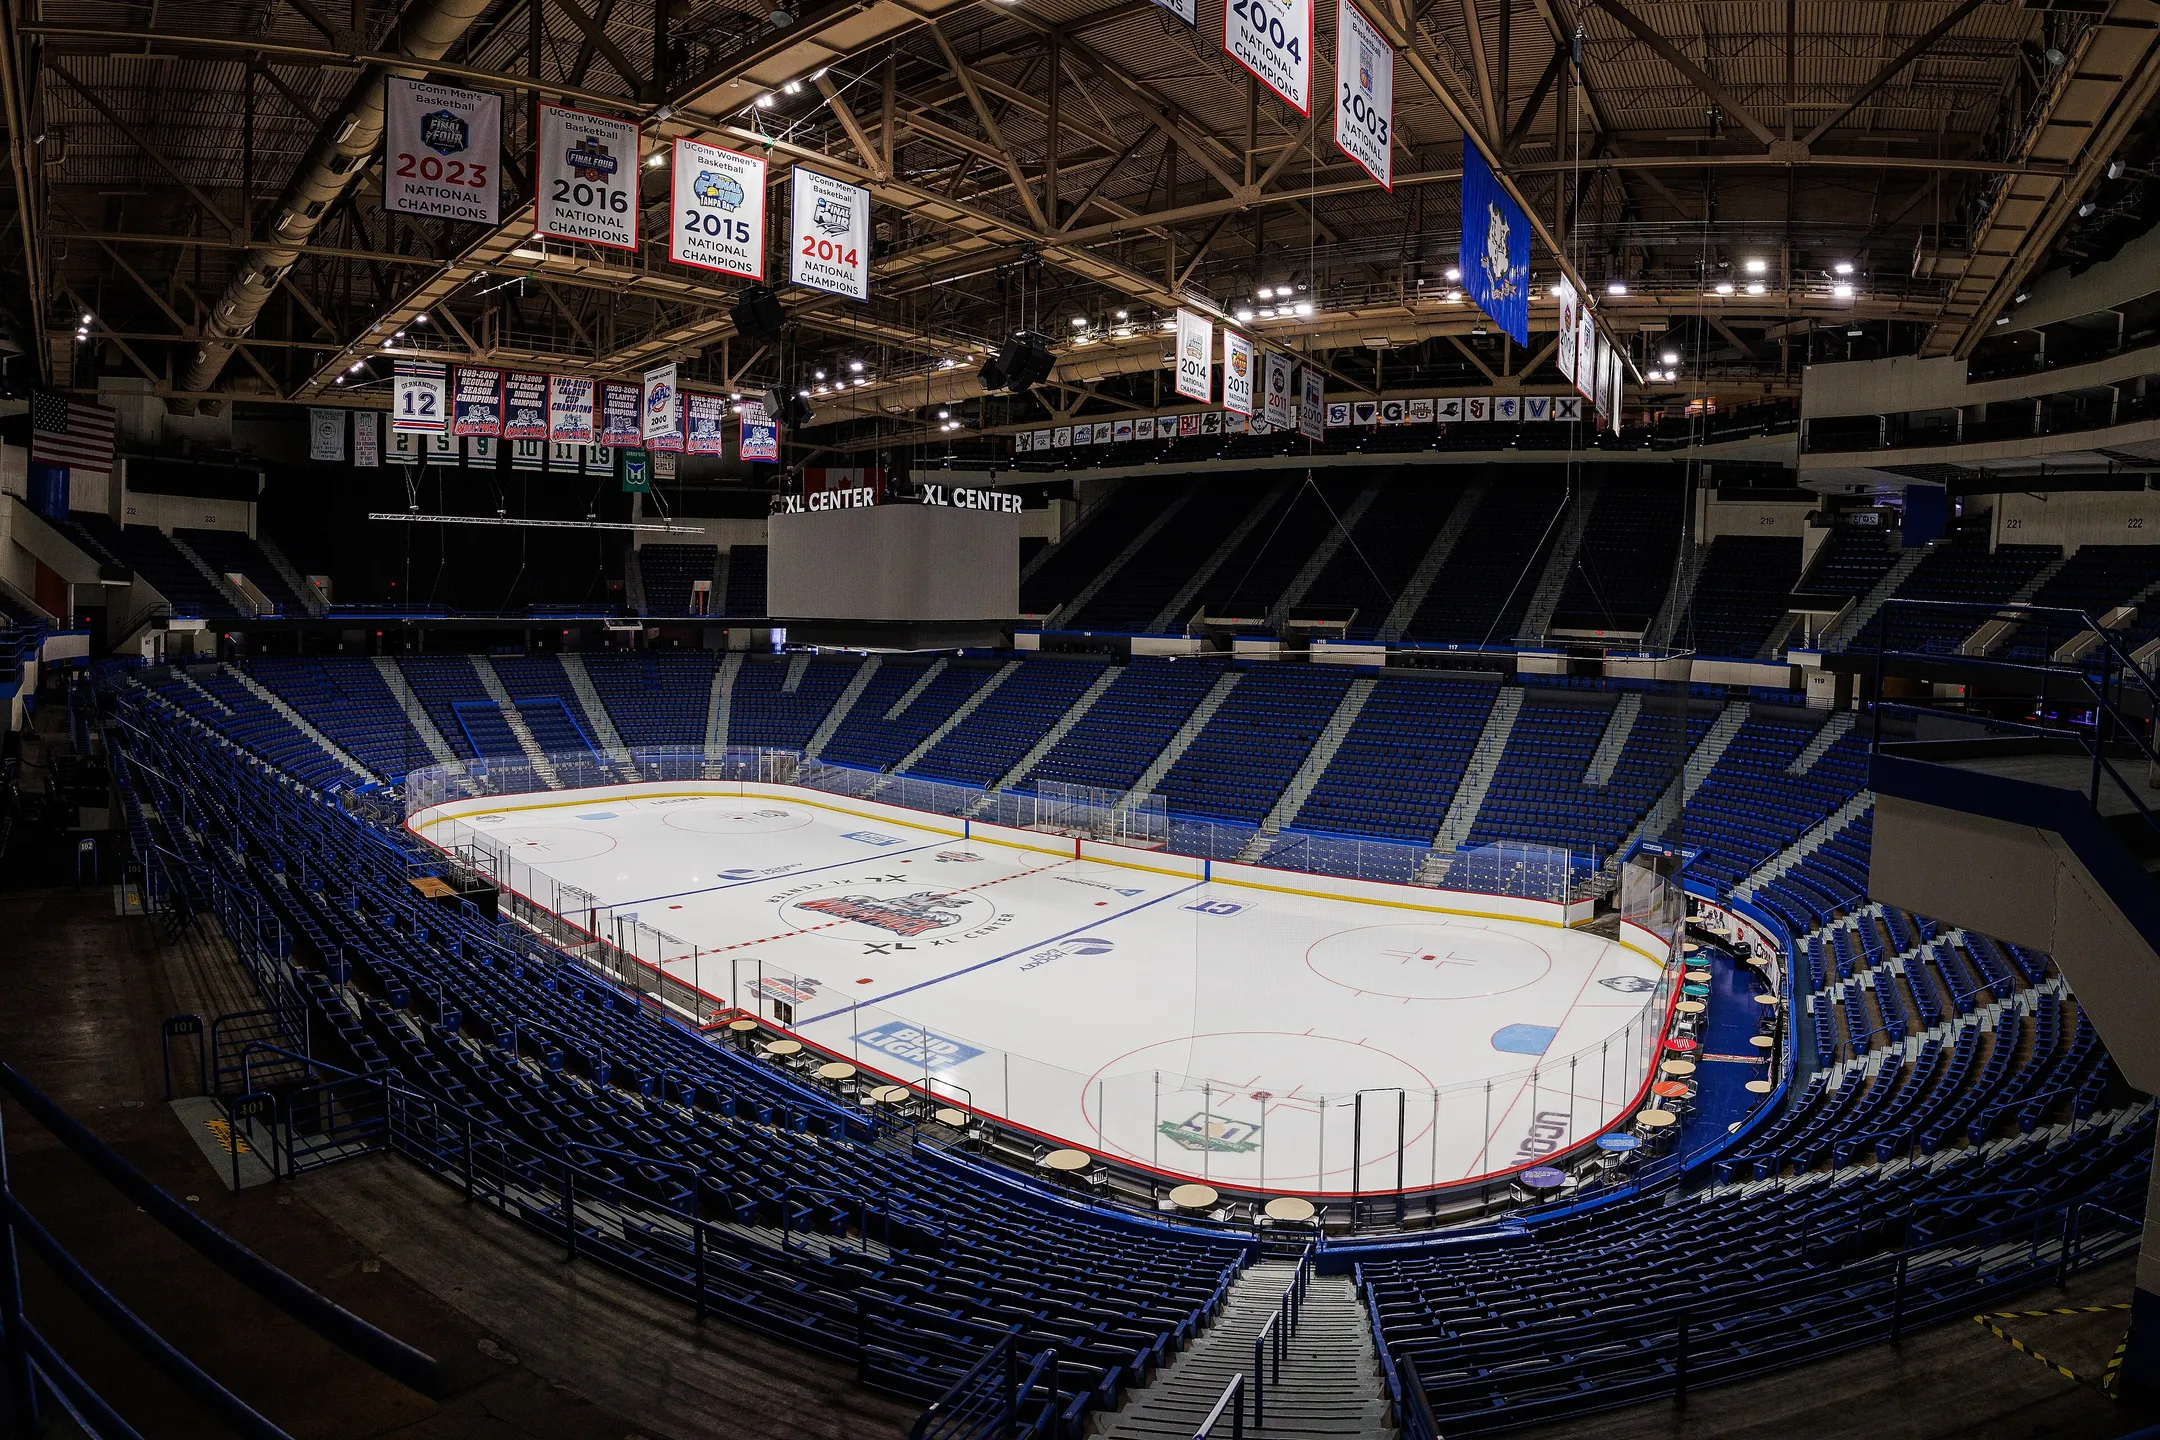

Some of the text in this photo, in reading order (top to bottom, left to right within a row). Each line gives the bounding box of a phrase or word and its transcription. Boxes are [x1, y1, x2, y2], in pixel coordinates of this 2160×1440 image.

[1344, 0, 1364, 25] UConn
[1233, 0, 1301, 65] 2004
[1352, 22, 1380, 58] Basketball
[1241, 25, 1293, 80] NATIONAL
[1235, 41, 1299, 101] CHAMPIONS
[409, 82, 482, 101] UConn Men's
[416, 94, 475, 112] Basketball
[549, 107, 634, 133] UConn Women's
[1342, 82, 1388, 146] 2003
[430, 119, 460, 134] FINAL
[565, 121, 618, 140] Basketball
[432, 130, 463, 144] FOUR
[1345, 119, 1383, 161] NATIONAL
[570, 153, 614, 169] FINAL FOUR
[684, 142, 757, 168] UConn Women's
[1341, 133, 1384, 180] CHAMPIONS
[396, 153, 487, 188] 2023
[697, 156, 744, 174] Basketball
[809, 174, 857, 194] UConn Men's
[404, 183, 481, 204] NATIONAL
[552, 178, 628, 214] 2016
[813, 185, 852, 203] Basketball
[397, 198, 487, 220] CHAMPIONS
[700, 195, 735, 213] TAMPA BAY
[825, 201, 851, 218] FINAL
[555, 207, 624, 229] NATIONAL
[814, 205, 850, 228] FOUR
[549, 221, 629, 244] CHAMPIONS
[685, 209, 750, 243] 2015
[688, 237, 748, 258] NATIONAL
[802, 235, 859, 269] 2014
[682, 249, 753, 272] CHAMPIONS
[805, 260, 855, 281] NATIONAL
[800, 273, 859, 295] CHAMPIONS
[457, 368, 499, 380] 1999-2000
[1181, 358, 1206, 380] 2014
[401, 381, 438, 392] GERNANDER
[461, 377, 495, 388] REGULAR
[463, 386, 493, 396] SEASON
[506, 381, 546, 392] NEW ENGLAND
[552, 378, 592, 389] 1999-2000
[606, 385, 639, 394] 2003-2004
[1180, 384, 1206, 399] CHAMPIONS
[1183, 376, 1205, 389] NATIONAL
[1228, 376, 1249, 395] 2013
[456, 394, 499, 404] CHAMPIONS
[514, 390, 540, 399] DIVISION
[559, 387, 586, 397] CALDER
[565, 396, 580, 404] CUP
[607, 393, 637, 402] ATLANTIC
[1229, 393, 1249, 405] NATIONAL
[1269, 392, 1286, 410] 2011
[403, 391, 437, 417] 12
[510, 398, 543, 408] CHAMPIONS
[551, 403, 592, 413] CHAMPIONS
[608, 400, 634, 409] DIVISION
[647, 386, 672, 417] MAAC
[692, 401, 721, 410] ATLANTIC
[1557, 399, 1579, 418] X
[604, 408, 637, 417] CHAMPIONS
[651, 415, 667, 426] 2000
[689, 412, 722, 420] CHAMPION
[1267, 415, 1288, 427] CHAMPIONS
[1269, 408, 1286, 419] NATIONAL
[1303, 406, 1321, 424] 2010
[649, 424, 669, 433] CHAMPIONS
[743, 418, 776, 428] CHAMPIONS
[397, 432, 409, 451] 2
[437, 432, 449, 451] 5
[477, 437, 488, 456] 9
[519, 440, 537, 457] 10
[556, 443, 572, 460] 11
[590, 445, 610, 465] 19
[785, 487, 874, 514] XL CENTER
[923, 484, 1022, 514] XL CENTER
[127, 507, 136, 515] 232
[205, 515, 216, 523] 233
[1760, 517, 1774, 525] 219
[2007, 519, 2022, 528] 221
[2128, 518, 2143, 528] 222
[81, 842, 93, 851] 102
[865, 875, 907, 883] XL
[1052, 876, 1113, 890] Technology
[765, 884, 822, 903] CENTER
[1184, 901, 1242, 915] CT
[963, 913, 1016, 939] CENTER
[862, 943, 917, 955] XL
[1030, 949, 1060, 961] EAST
[1019, 952, 1068, 972] HOCKEY
[174, 1021, 193, 1033] 101
[859, 1031, 956, 1071] LIGHT
[890, 1028, 960, 1056] BUD
[240, 1101, 265, 1116] 101
